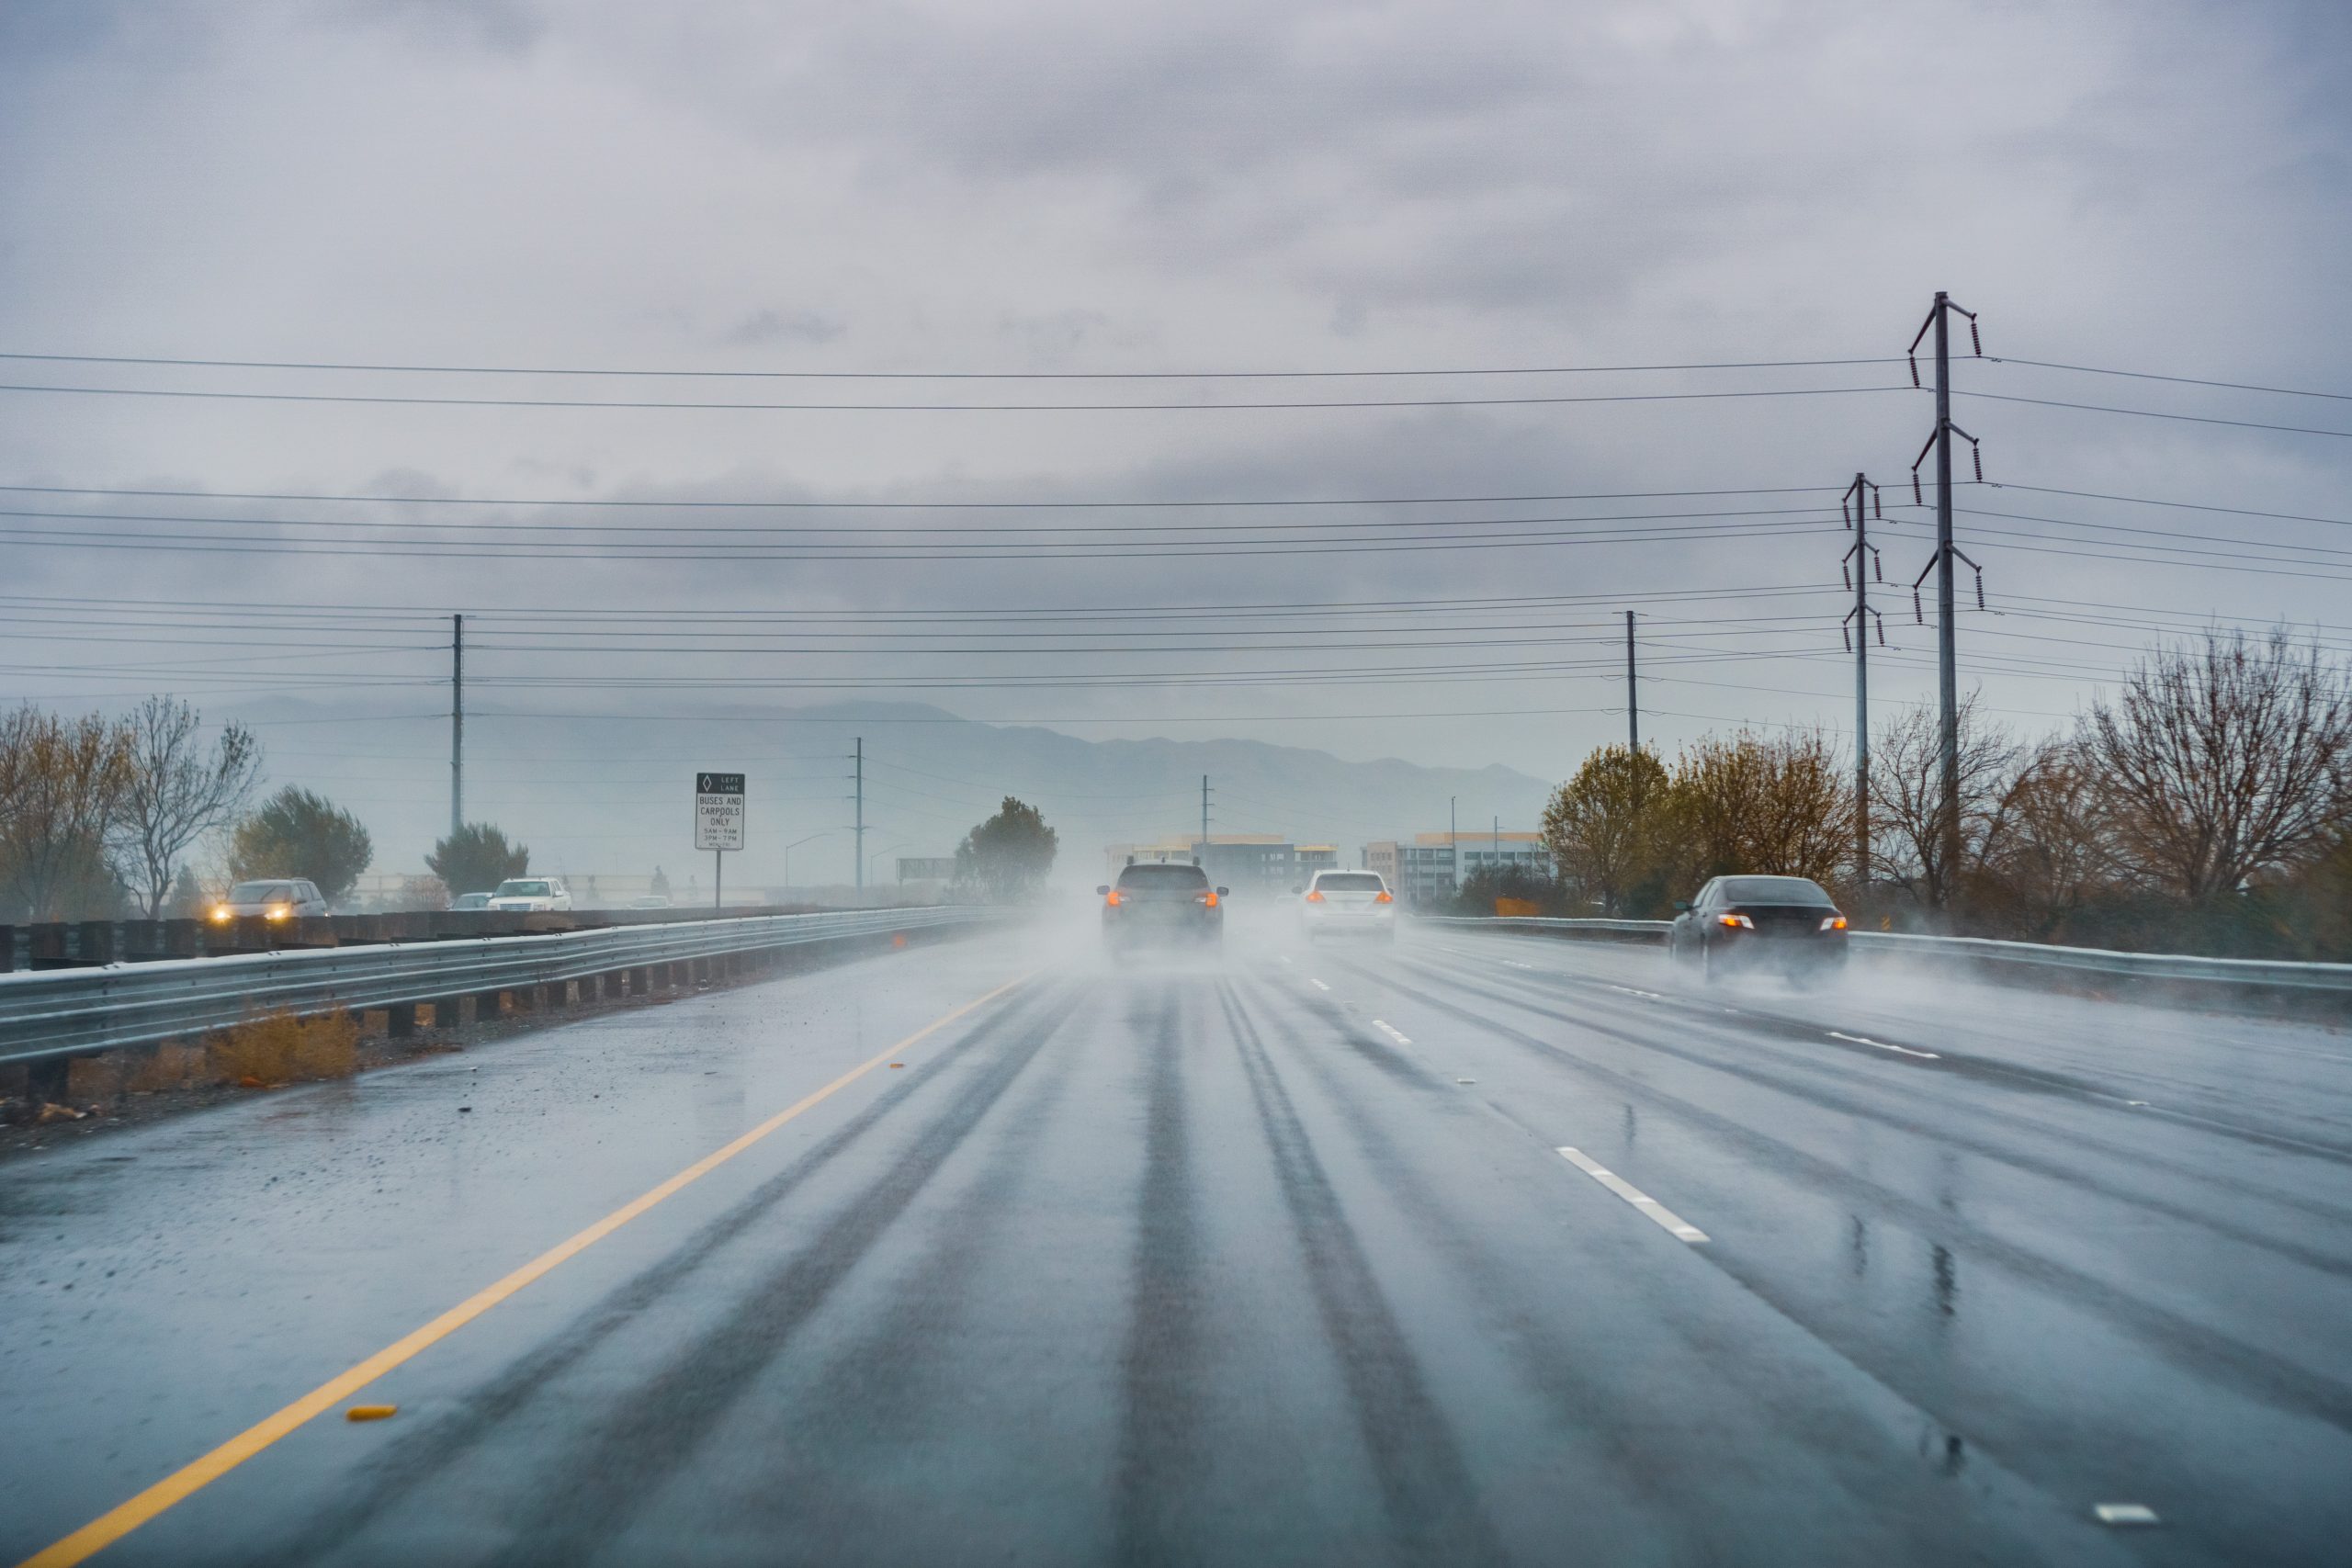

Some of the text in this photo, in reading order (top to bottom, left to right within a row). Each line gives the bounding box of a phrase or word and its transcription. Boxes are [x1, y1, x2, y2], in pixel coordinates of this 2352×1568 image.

[699, 796, 741, 806] BUSES AND
[701, 807, 740, 816] CARPOOLS
[710, 818, 729, 827] ONLY
